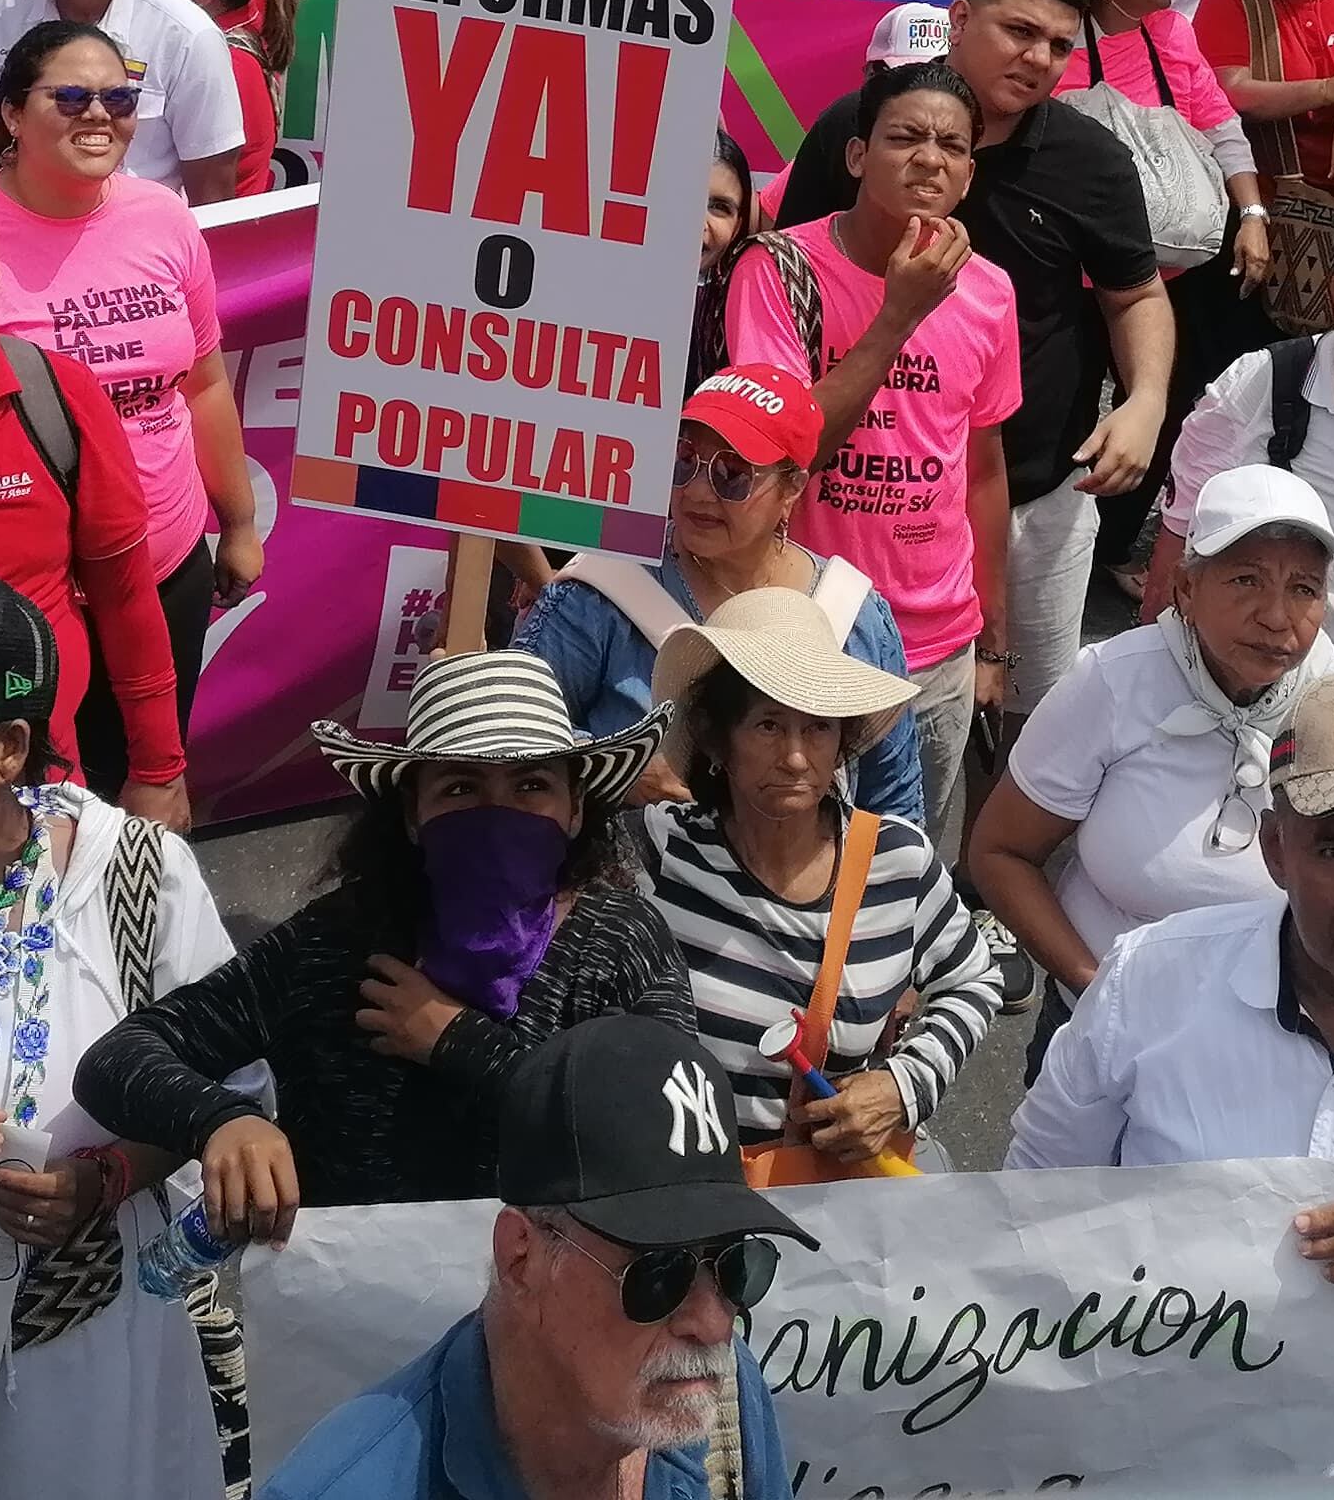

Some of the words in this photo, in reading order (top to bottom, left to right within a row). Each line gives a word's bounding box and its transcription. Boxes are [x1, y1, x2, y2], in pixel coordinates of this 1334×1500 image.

[394, 6, 672, 248] YA!
[46, 298, 79, 316] LA
[84, 283, 167, 308] ÚLTIMA
[474, 234, 535, 310] O
[53, 297, 178, 333] PALABRA
[55, 330, 94, 351] LA
[327, 289, 664, 410] CONSULTA
[334, 390, 636, 506] POPULAR
[817, 487, 906, 516] Popular
